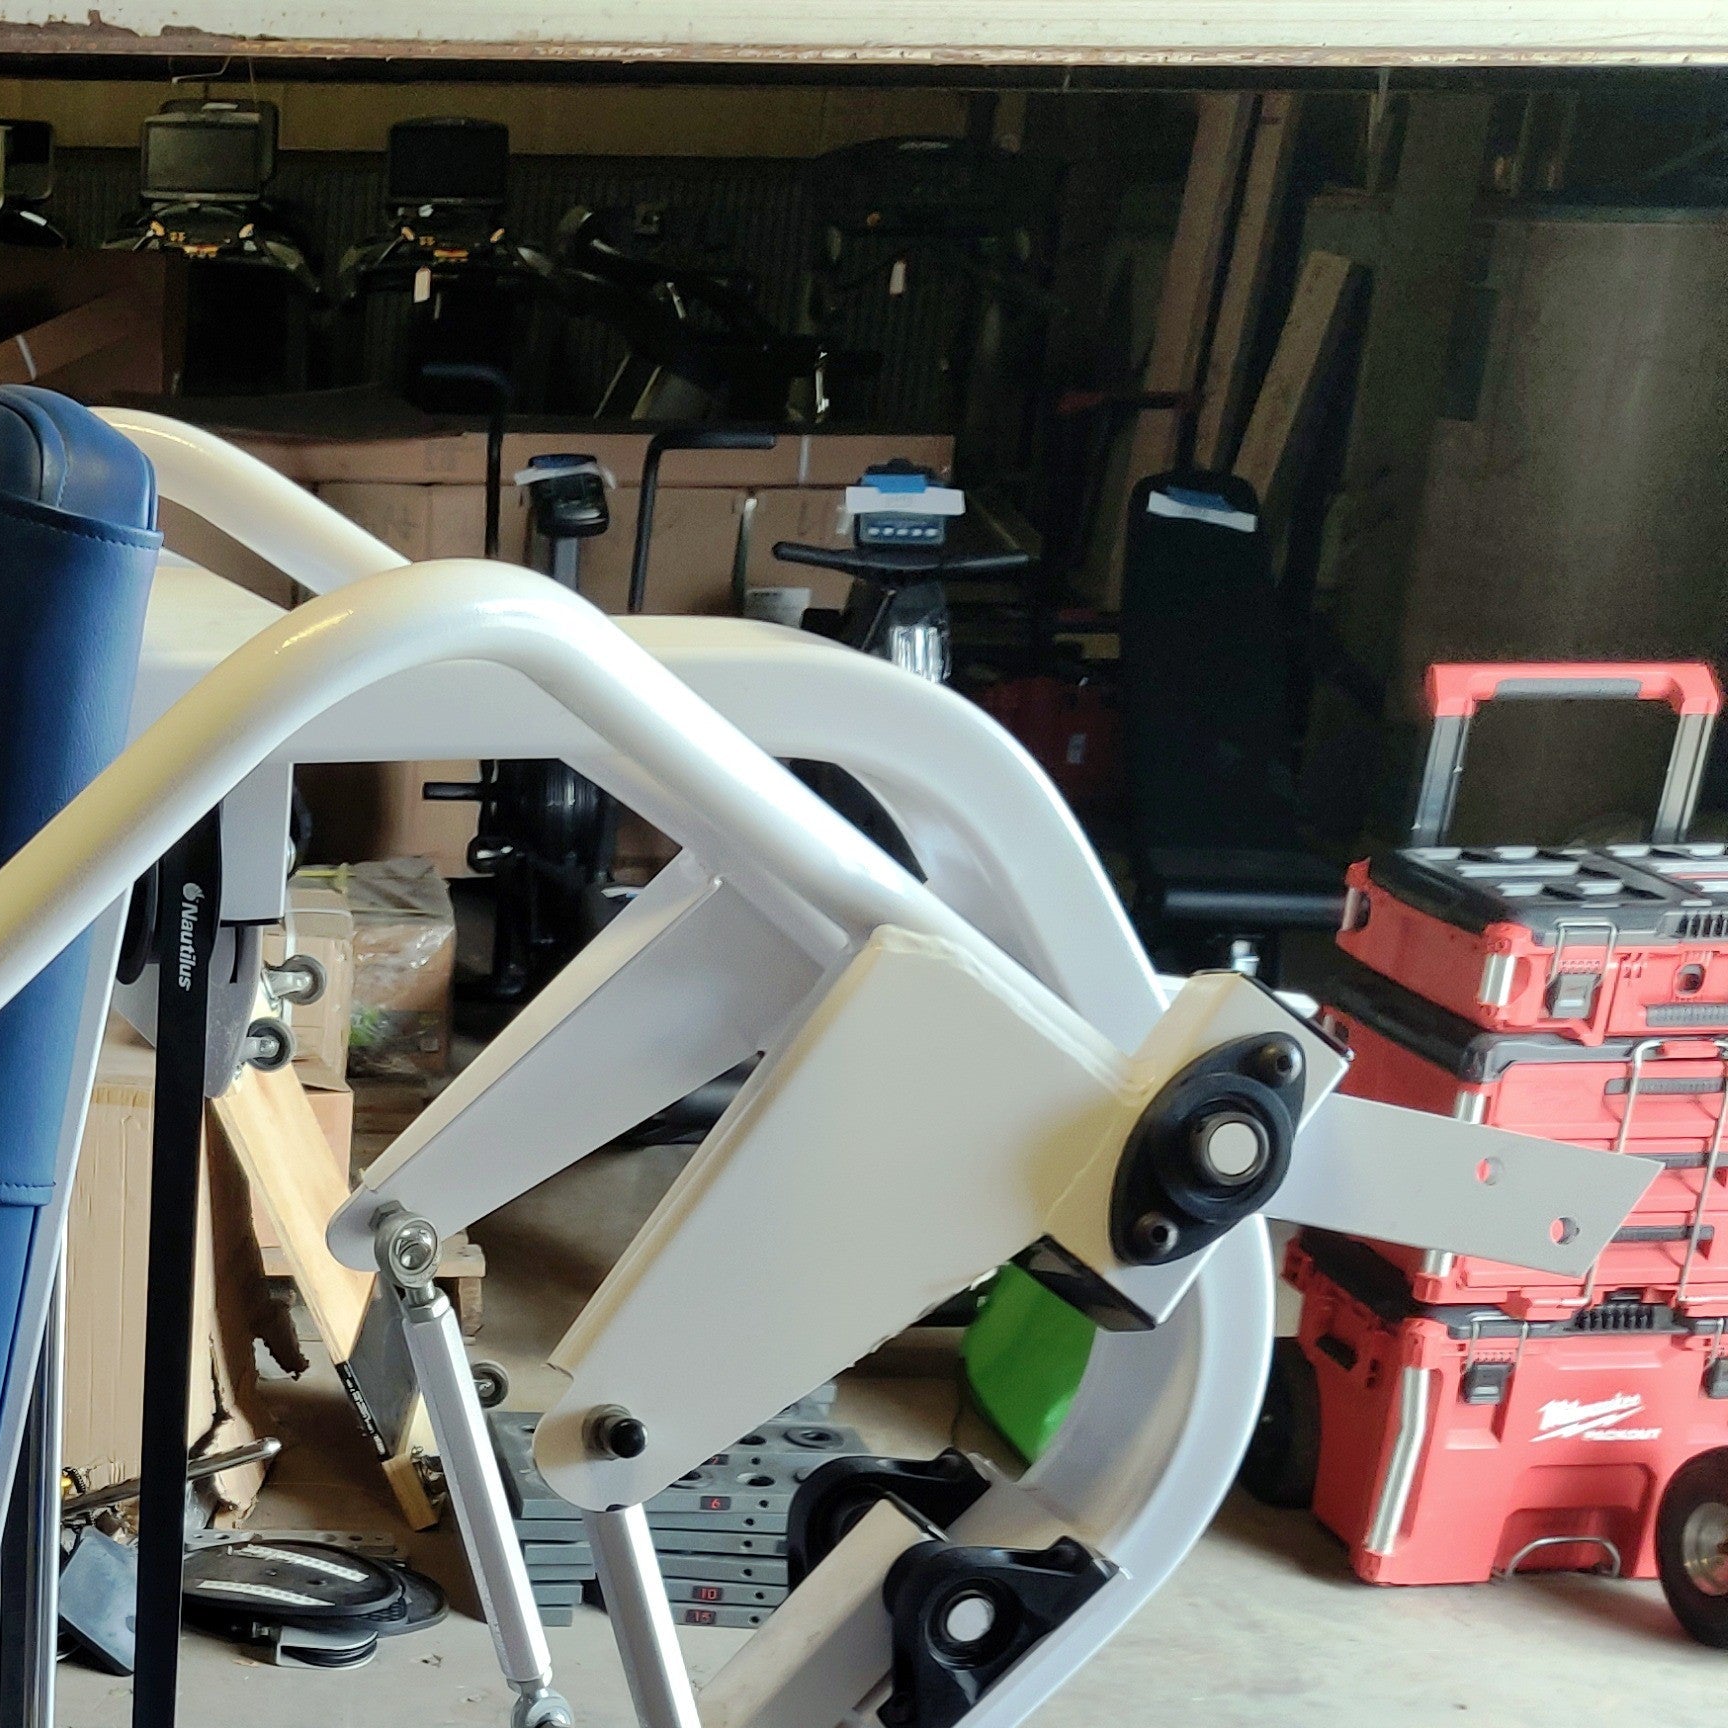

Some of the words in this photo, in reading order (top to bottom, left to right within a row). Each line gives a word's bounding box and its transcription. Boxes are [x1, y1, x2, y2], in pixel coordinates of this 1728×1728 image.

[178, 901, 199, 992] Nautilus
[710, 1498, 721, 1509] 6
[700, 1588, 718, 1600] 10
